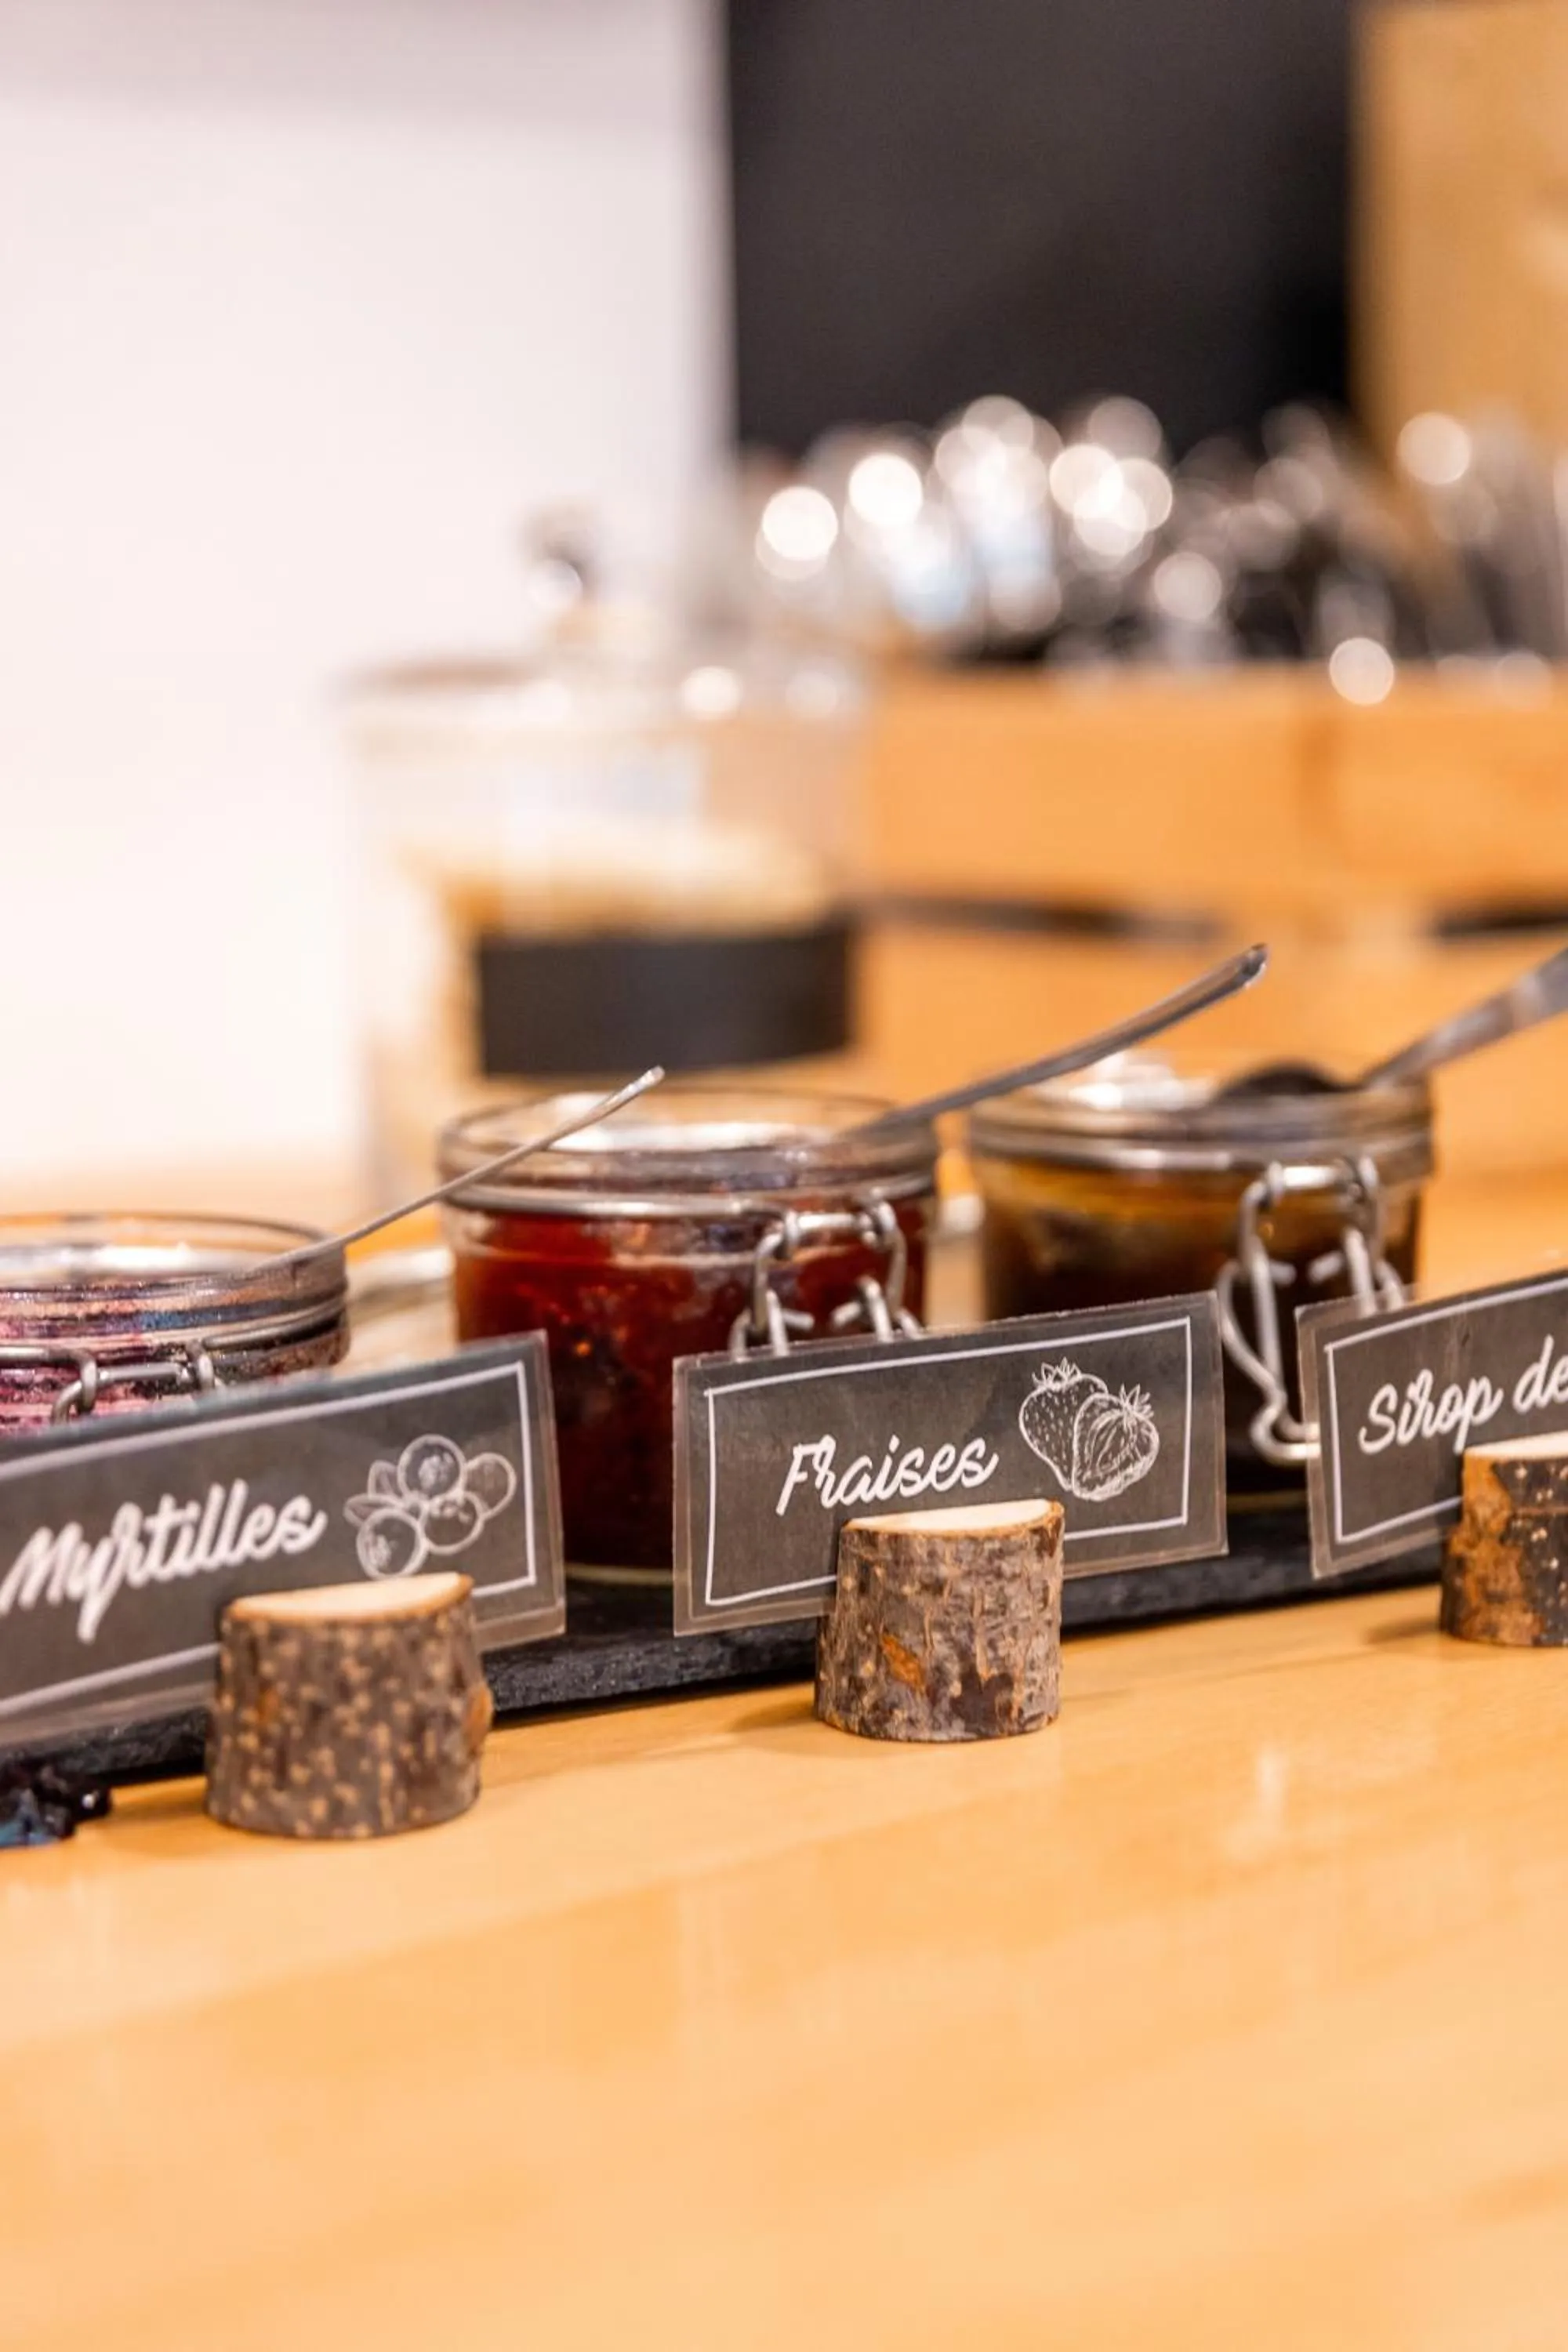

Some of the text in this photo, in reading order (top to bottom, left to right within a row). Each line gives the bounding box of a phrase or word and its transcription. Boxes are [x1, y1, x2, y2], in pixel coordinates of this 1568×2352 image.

[1359, 1334, 1568, 1454] Sirop de
[776, 1434, 999, 1515] Fraises
[0, 1478, 328, 1642] Myrtilles
